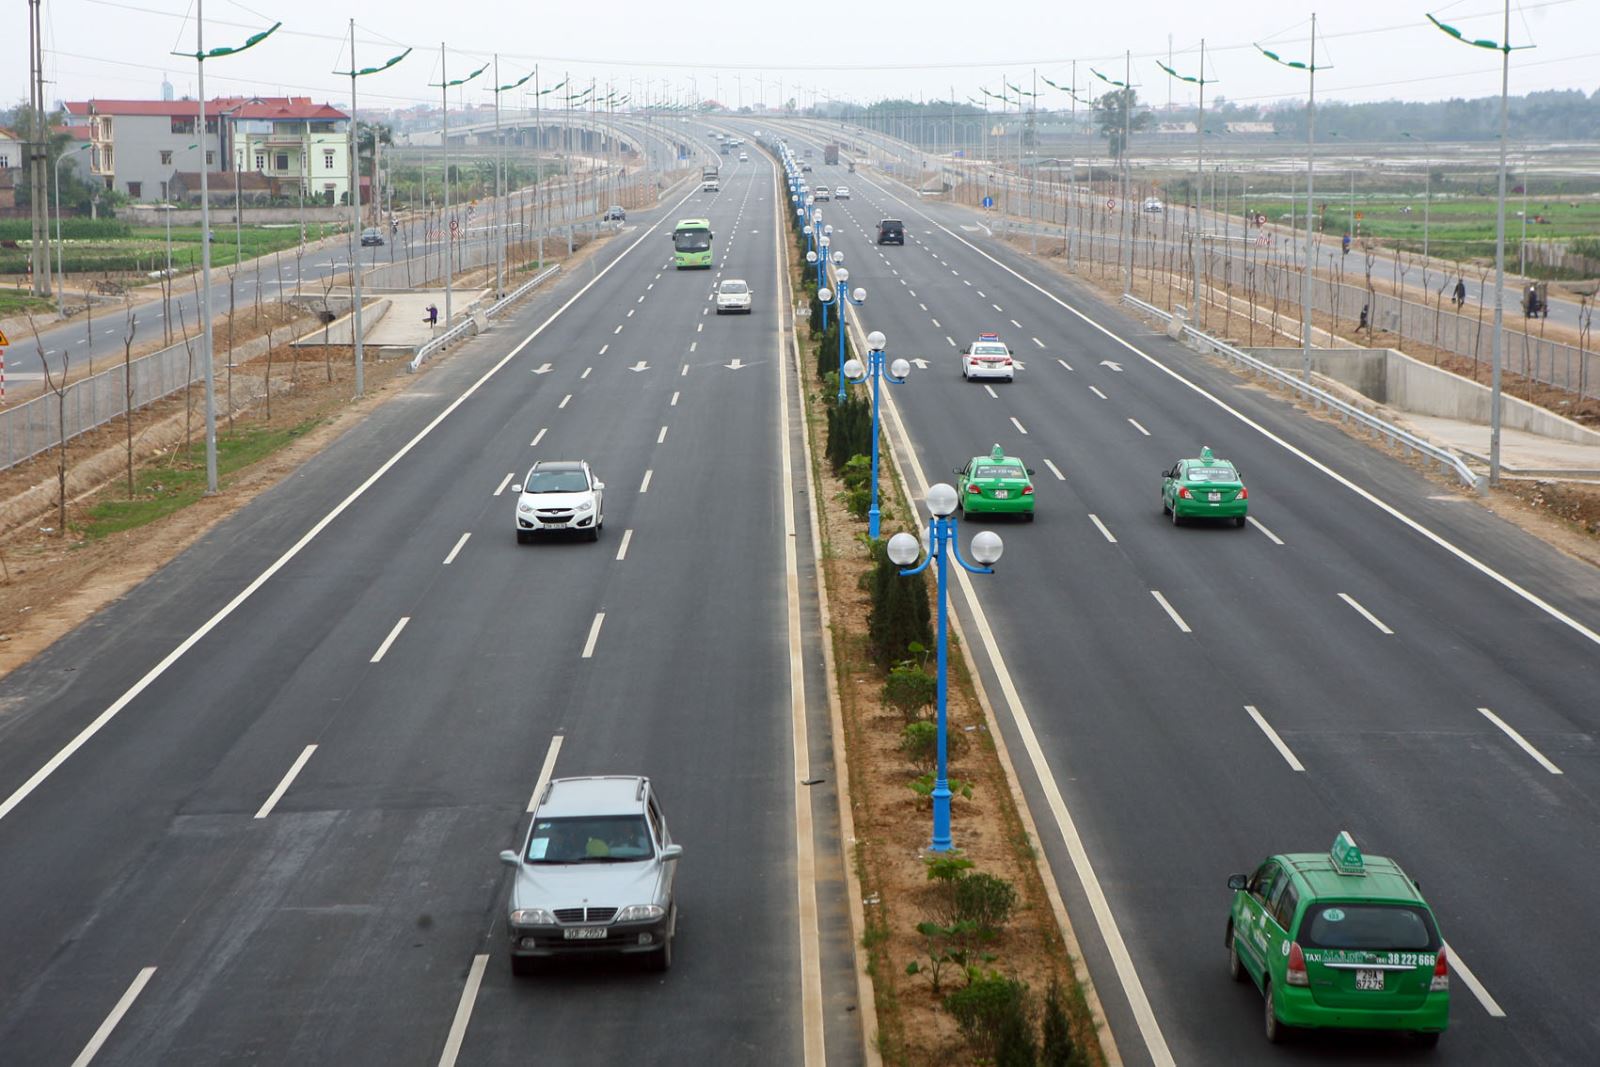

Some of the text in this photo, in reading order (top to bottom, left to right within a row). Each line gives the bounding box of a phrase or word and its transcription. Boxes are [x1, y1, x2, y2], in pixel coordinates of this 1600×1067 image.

[1305, 953, 1321, 962] TAXI
[1388, 953, 1399, 965] 38
[1401, 954, 1417, 965] 222
[1419, 955, 1435, 966] 666
[1362, 970, 1377, 979] 29A
